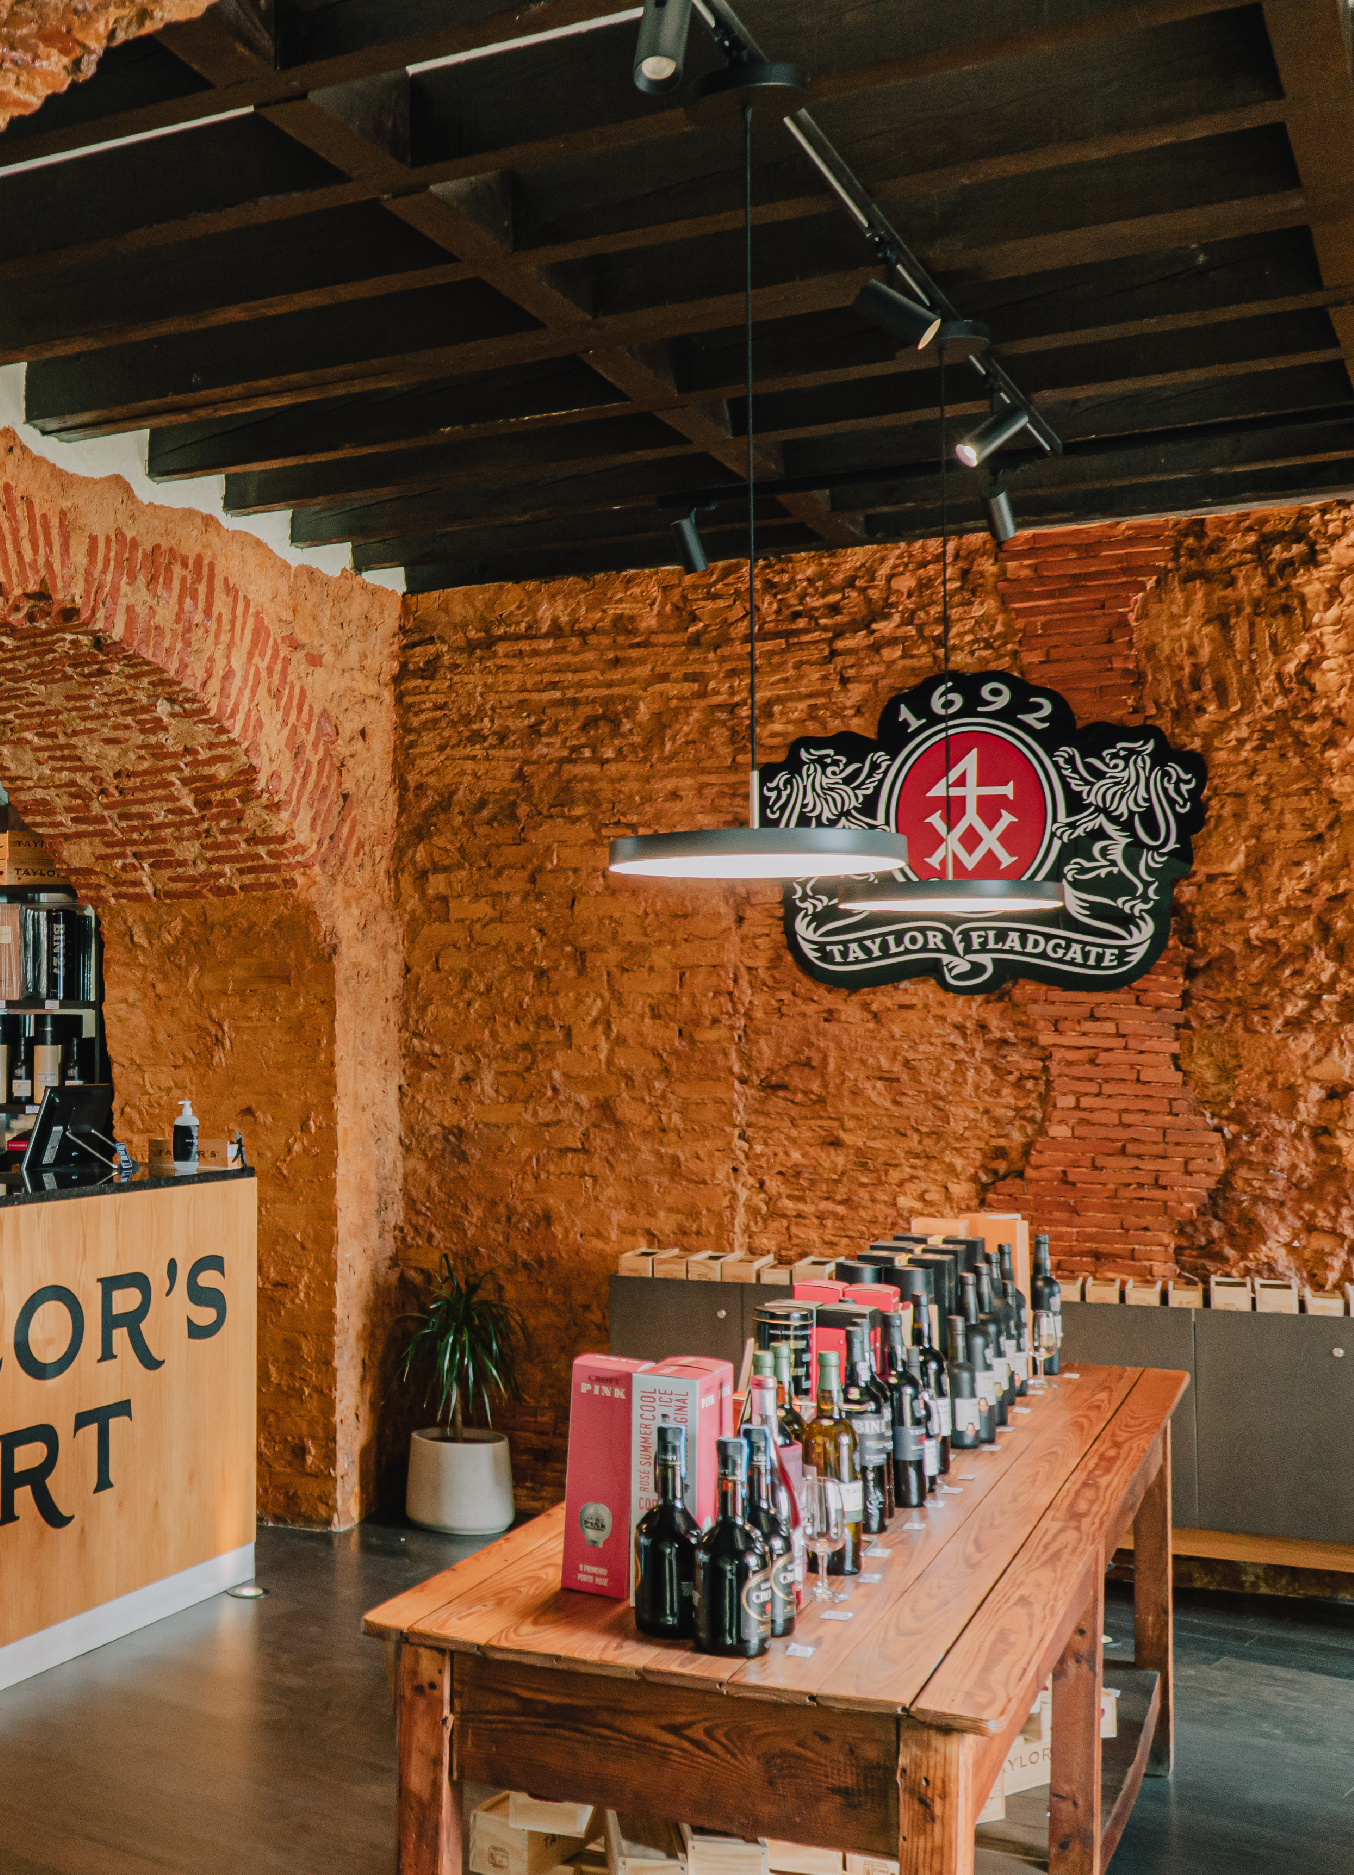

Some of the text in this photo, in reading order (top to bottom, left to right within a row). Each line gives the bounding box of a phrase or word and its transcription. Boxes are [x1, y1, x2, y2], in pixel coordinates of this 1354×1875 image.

[898, 681, 1053, 732] 1692
[825, 930, 1120, 968] TAYLOR FLADGATE
[580, 1382, 627, 1400] PINK
[588, 1374, 621, 1386] CROFT
[640, 1387, 658, 1422] COOL
[658, 1388, 673, 1408] ICE
[639, 1423, 653, 1467] SUMMER
